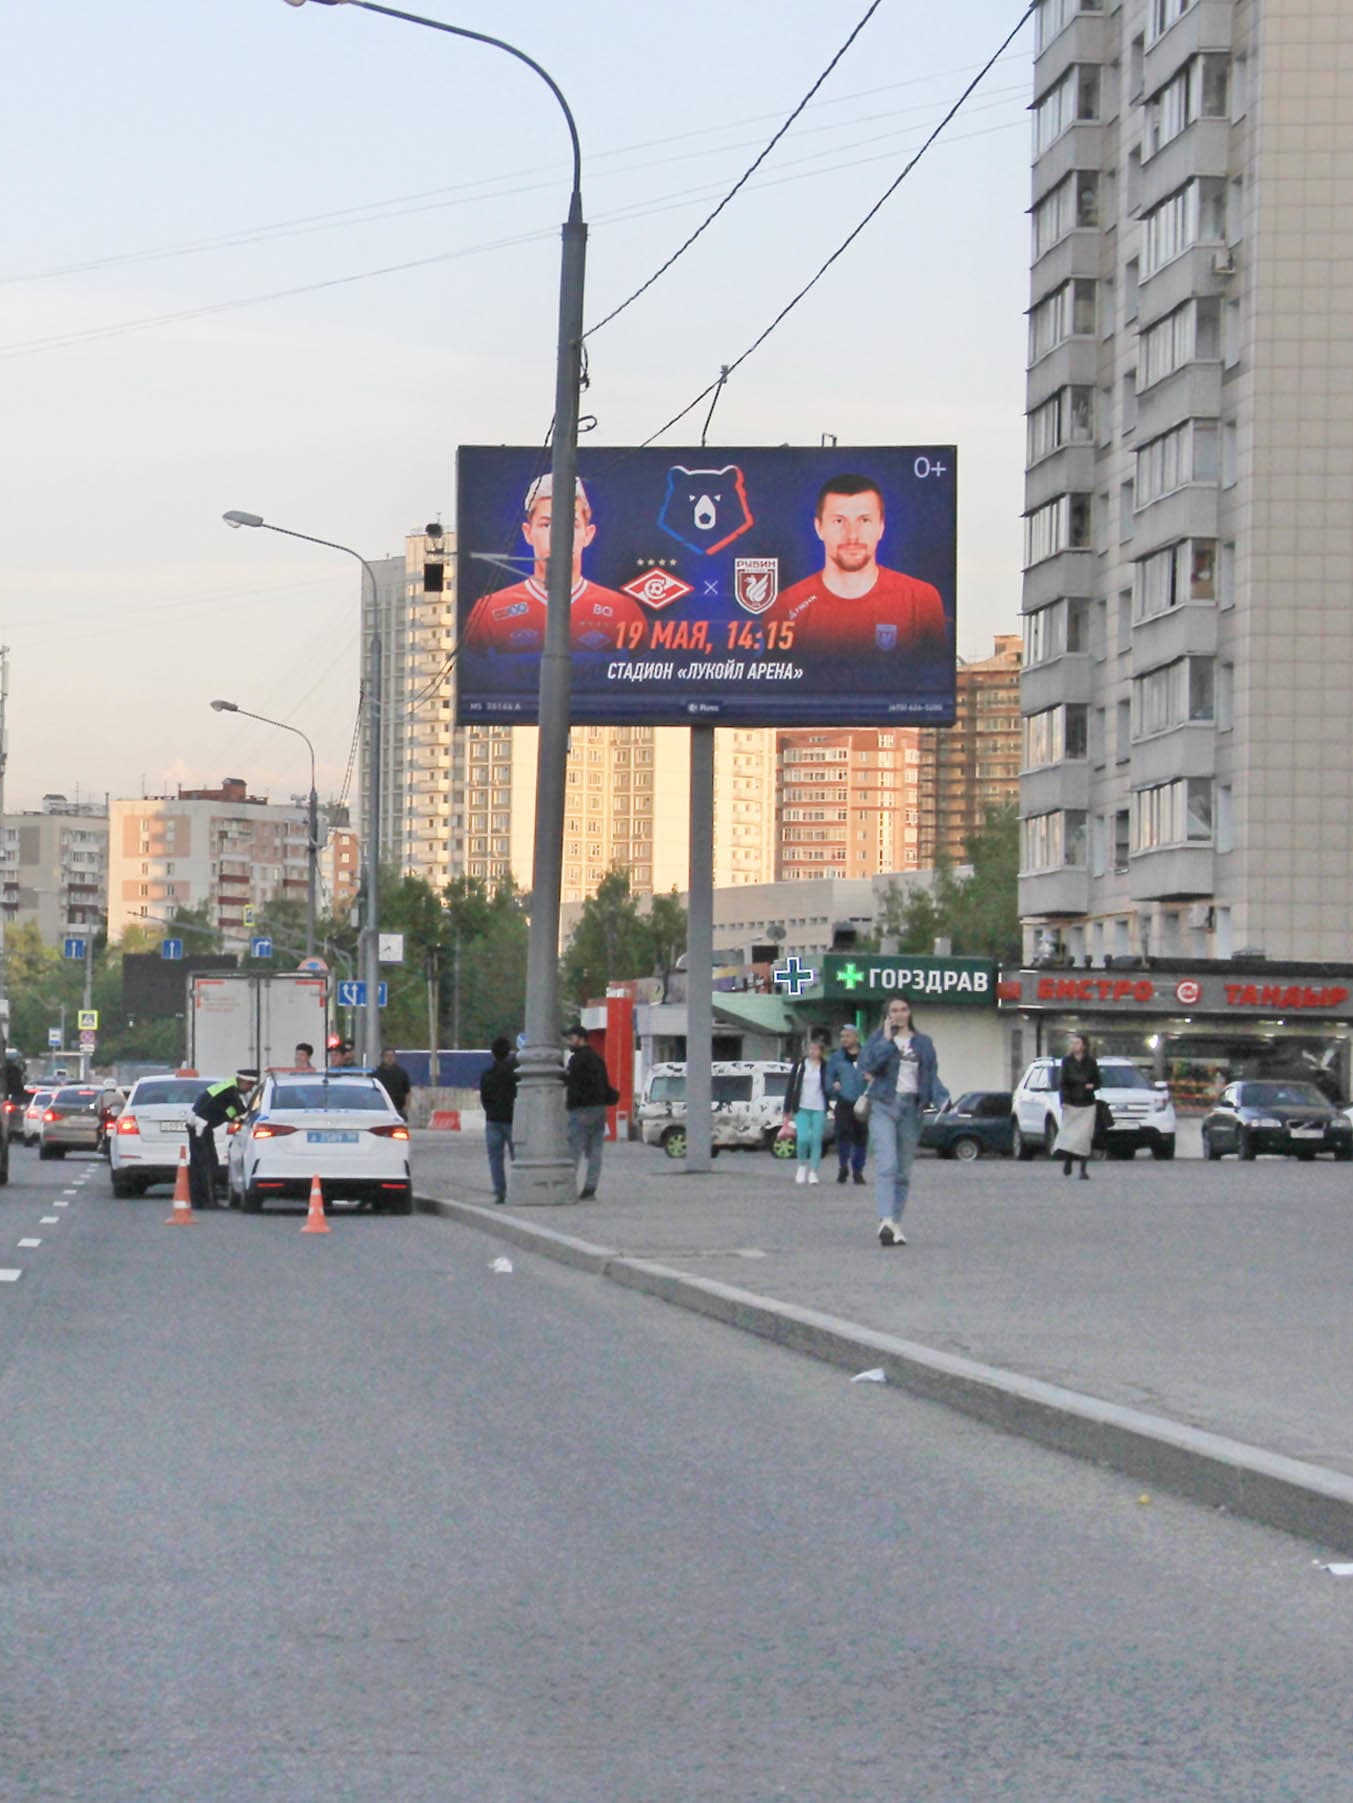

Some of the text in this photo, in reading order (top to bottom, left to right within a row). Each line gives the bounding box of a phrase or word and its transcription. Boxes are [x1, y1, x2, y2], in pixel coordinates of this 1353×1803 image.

[913, 456, 947, 478] 0+
[615, 620, 796, 655] 19 МАЯ, 14:15
[607, 659, 804, 682] СТАДИОН «ЛУКОЙЛ АРЕНА»
[868, 968, 989, 994] ГОРЗДРАВ
[1037, 978, 1155, 1001] БИСТРО
[1224, 983, 1350, 1009] ТАНДЫР
